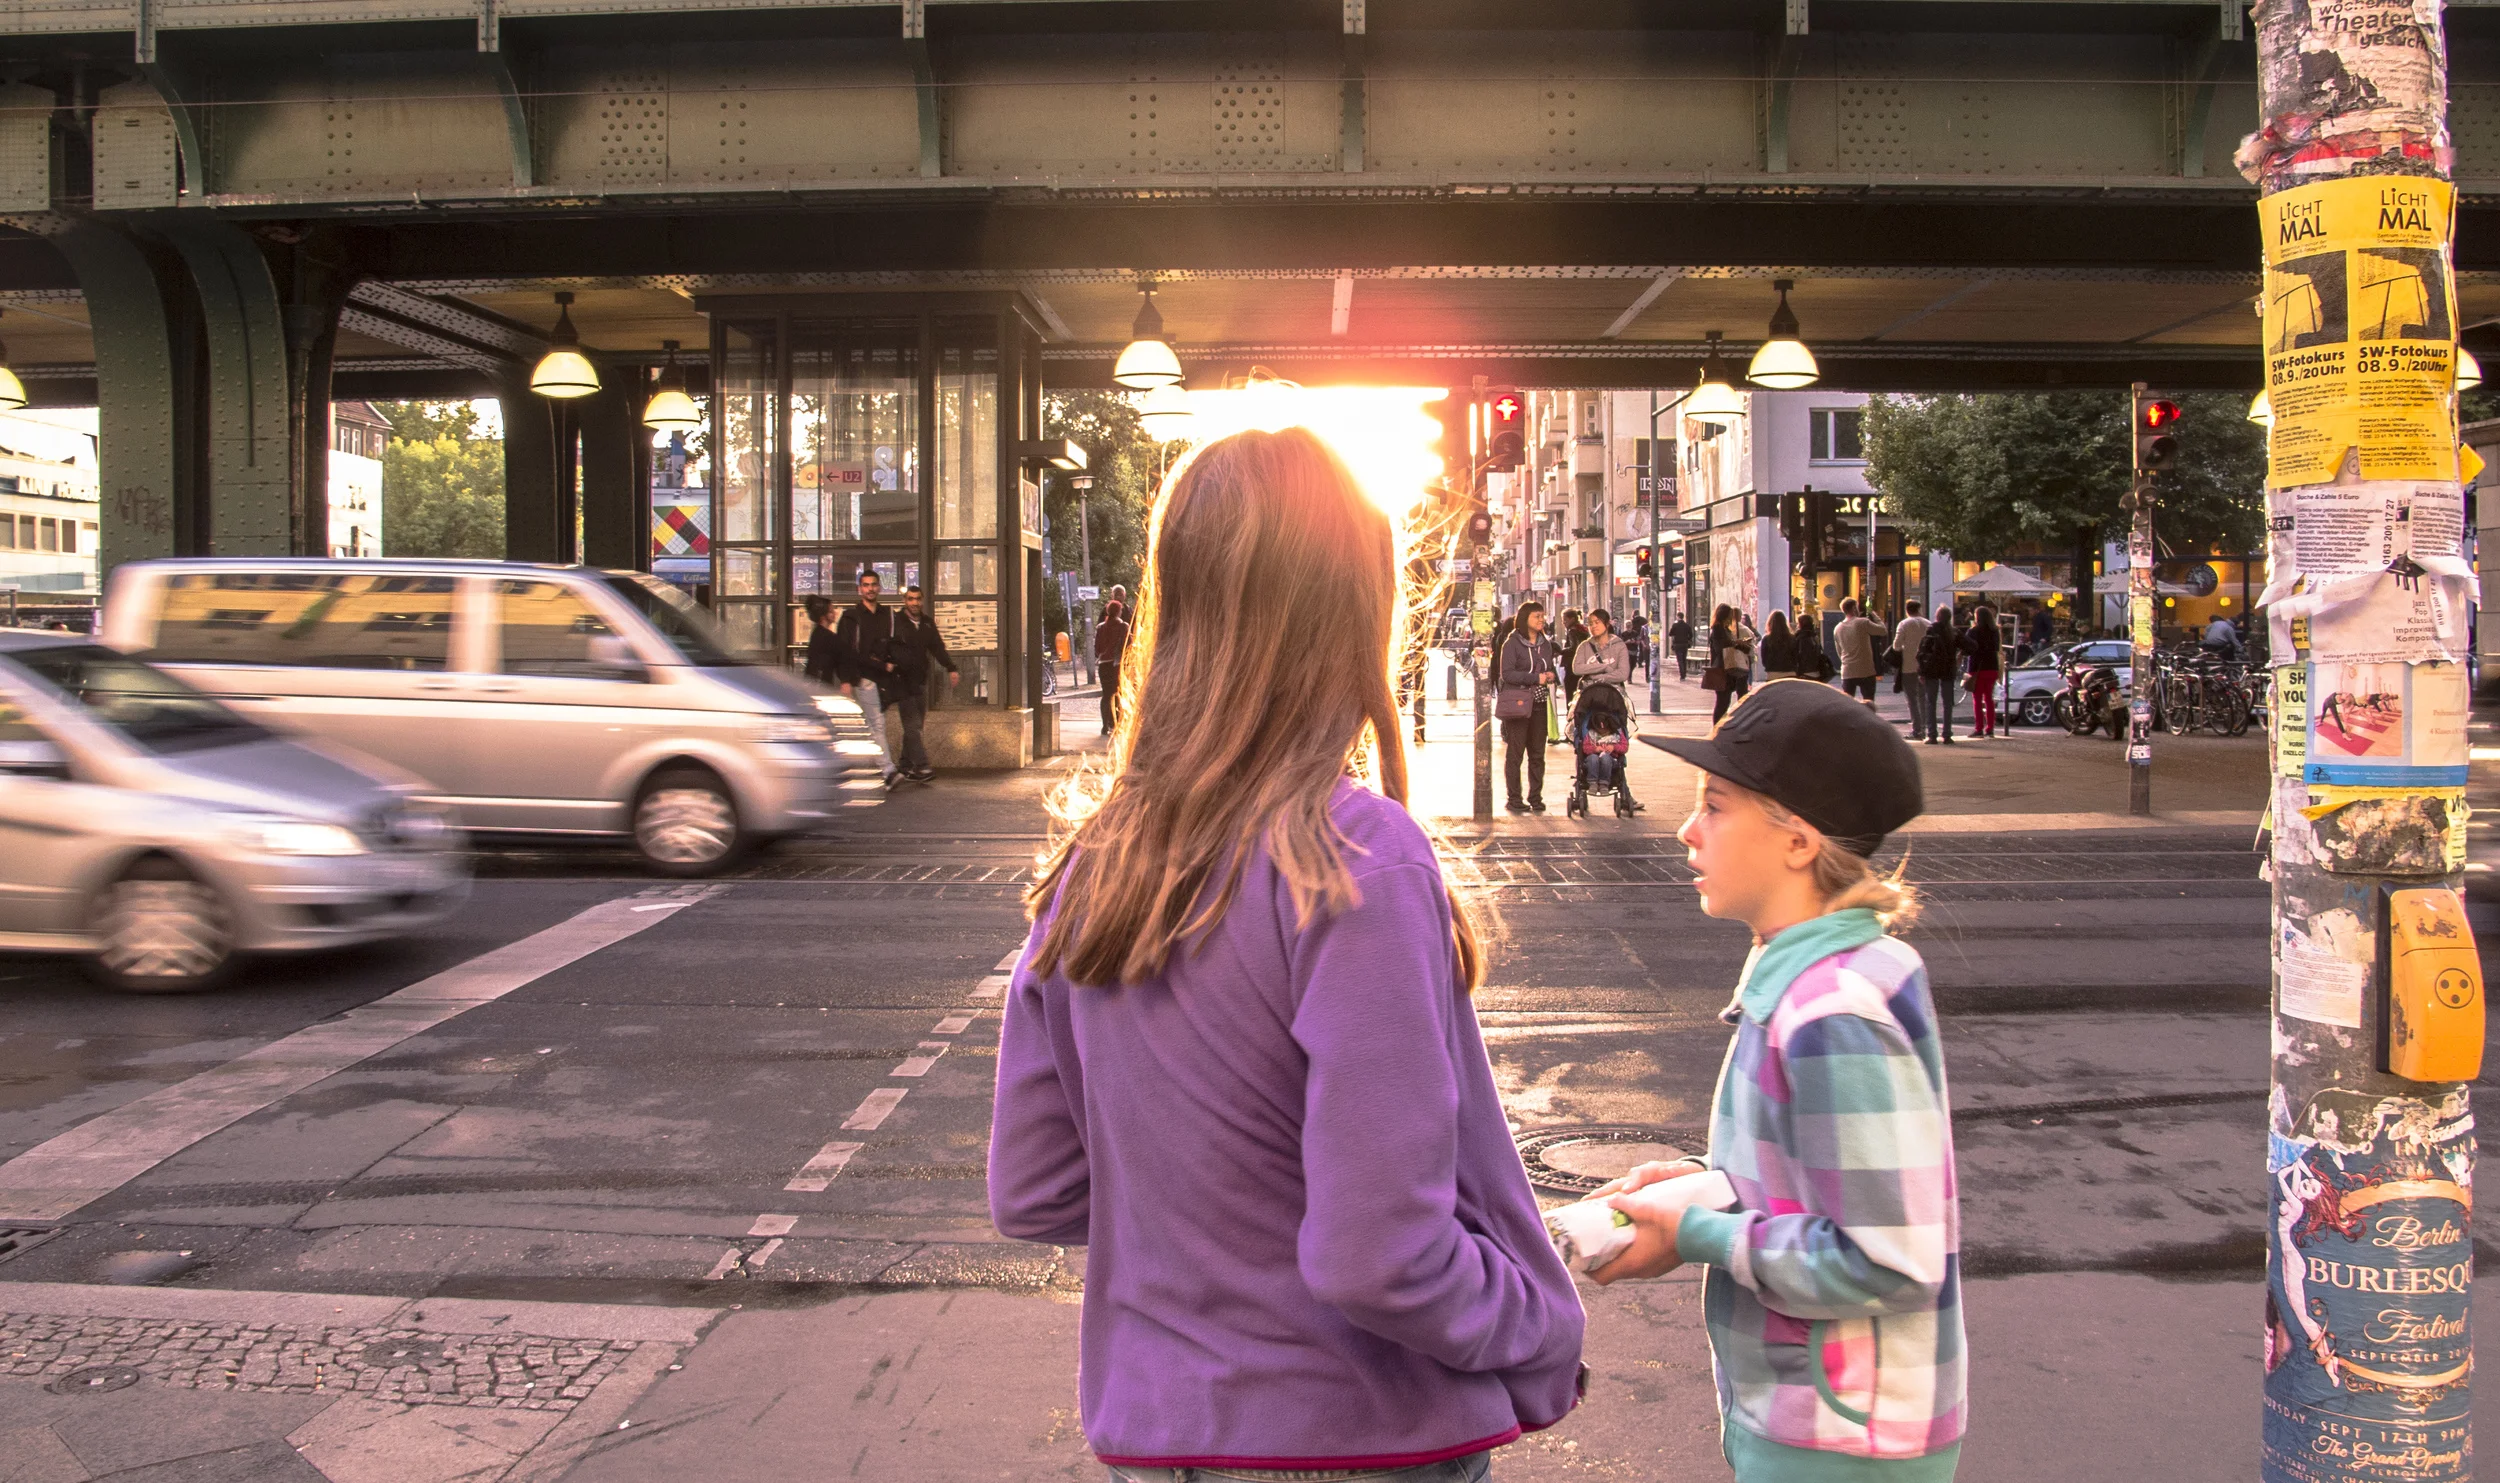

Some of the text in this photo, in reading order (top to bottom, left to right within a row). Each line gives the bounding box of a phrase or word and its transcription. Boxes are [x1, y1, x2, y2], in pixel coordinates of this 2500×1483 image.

[2280, 215, 2327, 245] MAL
[2378, 208, 2432, 231] MAL
[2272, 350, 2345, 372] SW-Fotokurs
[2359, 345, 2448, 358] SW-Fotokurs
[844, 471, 860, 482] U2
[2382, 499, 2394, 564] 0163 200 17 27
[793, 556, 819, 564] Coffee
[798, 569, 814, 578] Bio
[796, 581, 812, 590] Bio
[2412, 600, 2426, 608] Jazz
[2415, 608, 2428, 616] Pop
[2372, 1215, 2461, 1252] Berlin
[2307, 1256, 2473, 1294] BURLESQU
[2364, 1307, 2468, 1344] Festival
[2350, 1349, 2440, 1363] SEPTEMBER
[2320, 1420, 2362, 1439] SEPT
[2380, 1431, 2428, 1444] 17TH
[2440, 1427, 2465, 1441] 9PM
[2312, 1434, 2349, 1457] The
[2351, 1442, 2410, 1468] Grand
[2411, 1446, 2461, 1475] Opening
